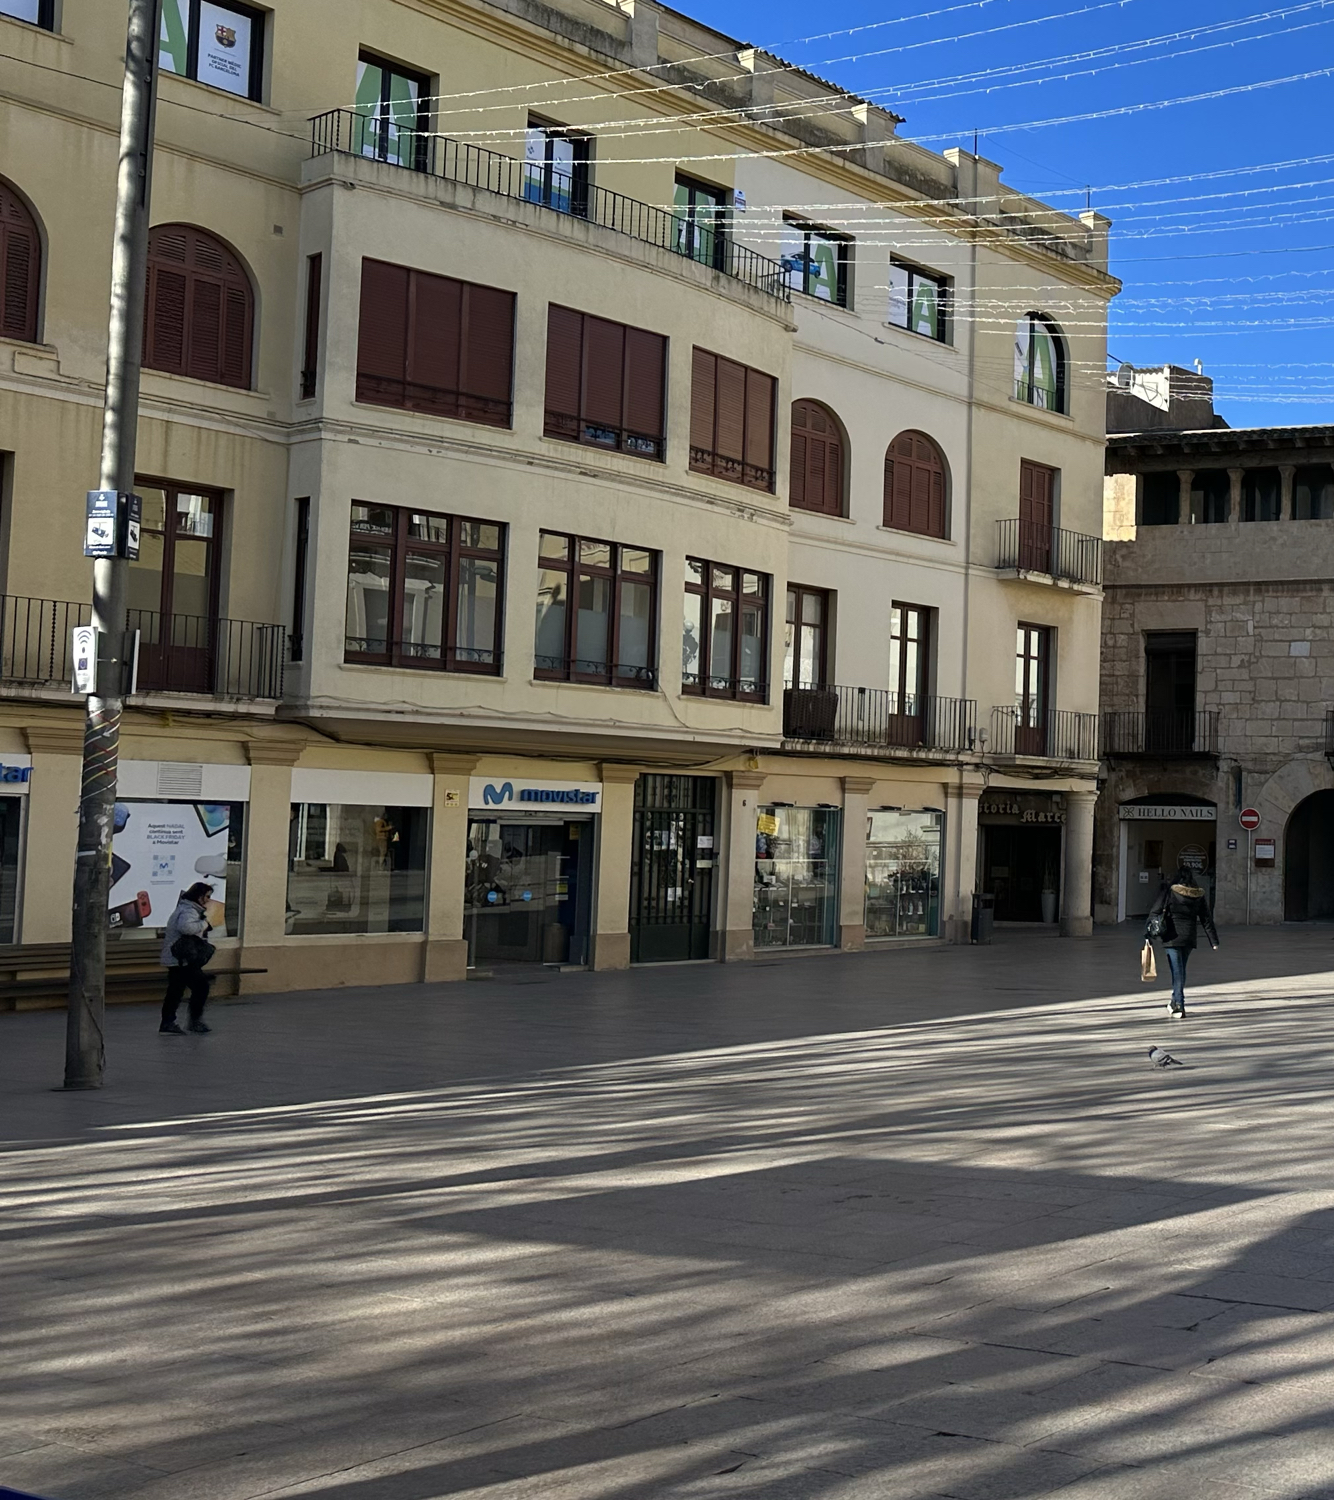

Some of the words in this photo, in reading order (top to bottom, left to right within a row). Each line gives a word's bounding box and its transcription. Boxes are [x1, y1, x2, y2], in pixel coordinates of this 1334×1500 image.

[214, 64, 240, 77] BARCELONA
[520, 788, 599, 805] movistar
[1138, 808, 1176, 818] HELLO
[1180, 808, 1214, 818] NAILS
